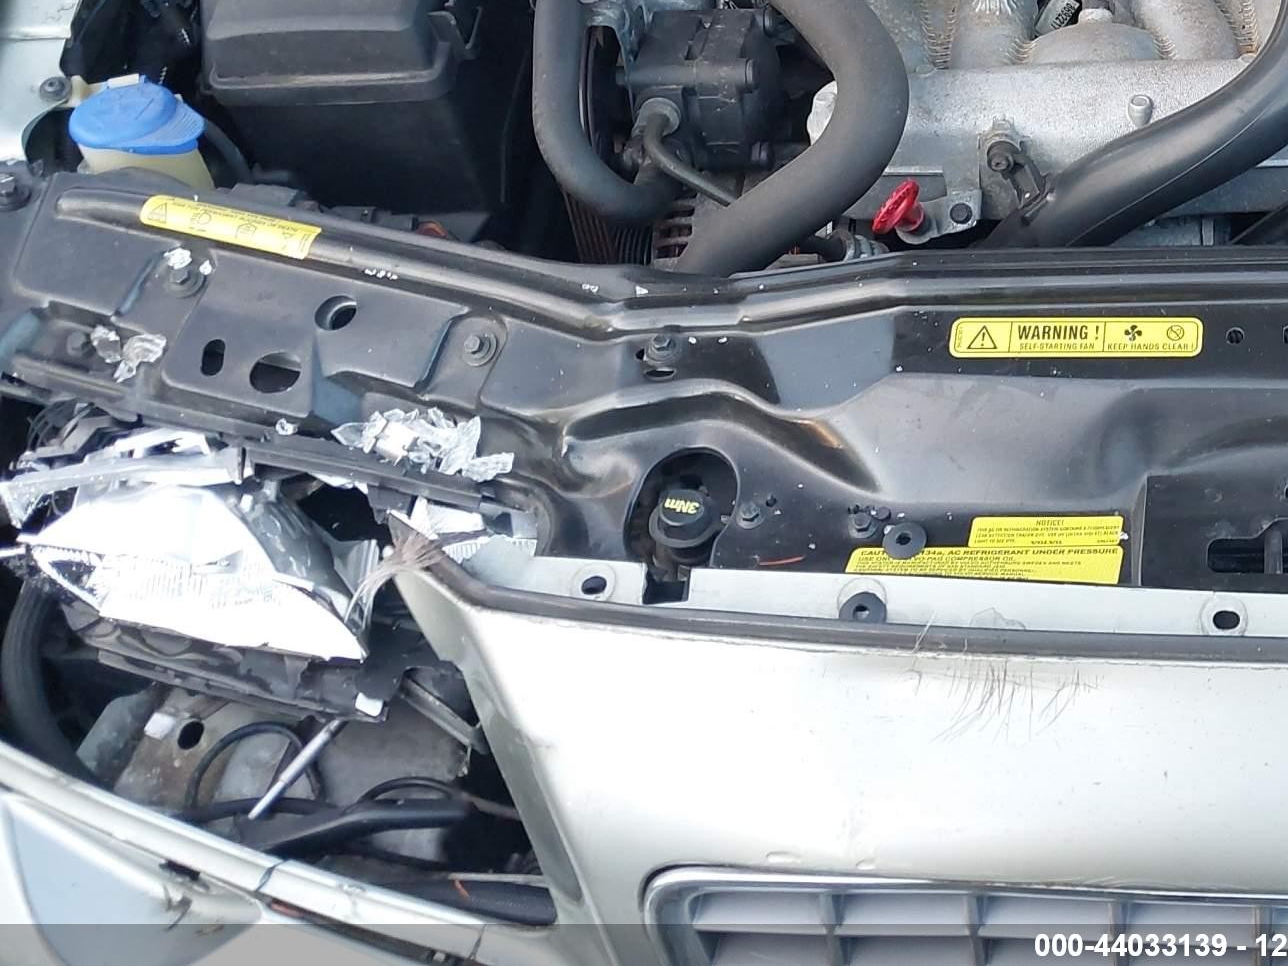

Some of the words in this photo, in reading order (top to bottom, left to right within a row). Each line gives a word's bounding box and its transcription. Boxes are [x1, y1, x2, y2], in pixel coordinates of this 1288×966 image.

[1017, 325, 1089, 340] WARNING
[1095, 325, 1101, 340] !
[1019, 342, 1079, 351] SELF-STARTING
[1080, 342, 1095, 351] FAN
[1107, 342, 1128, 351] KEEP
[1130, 342, 1160, 351] HANDS
[1161, 342, 1188, 351] CLEAR
[1035, 519, 1065, 527] NOTICE!
